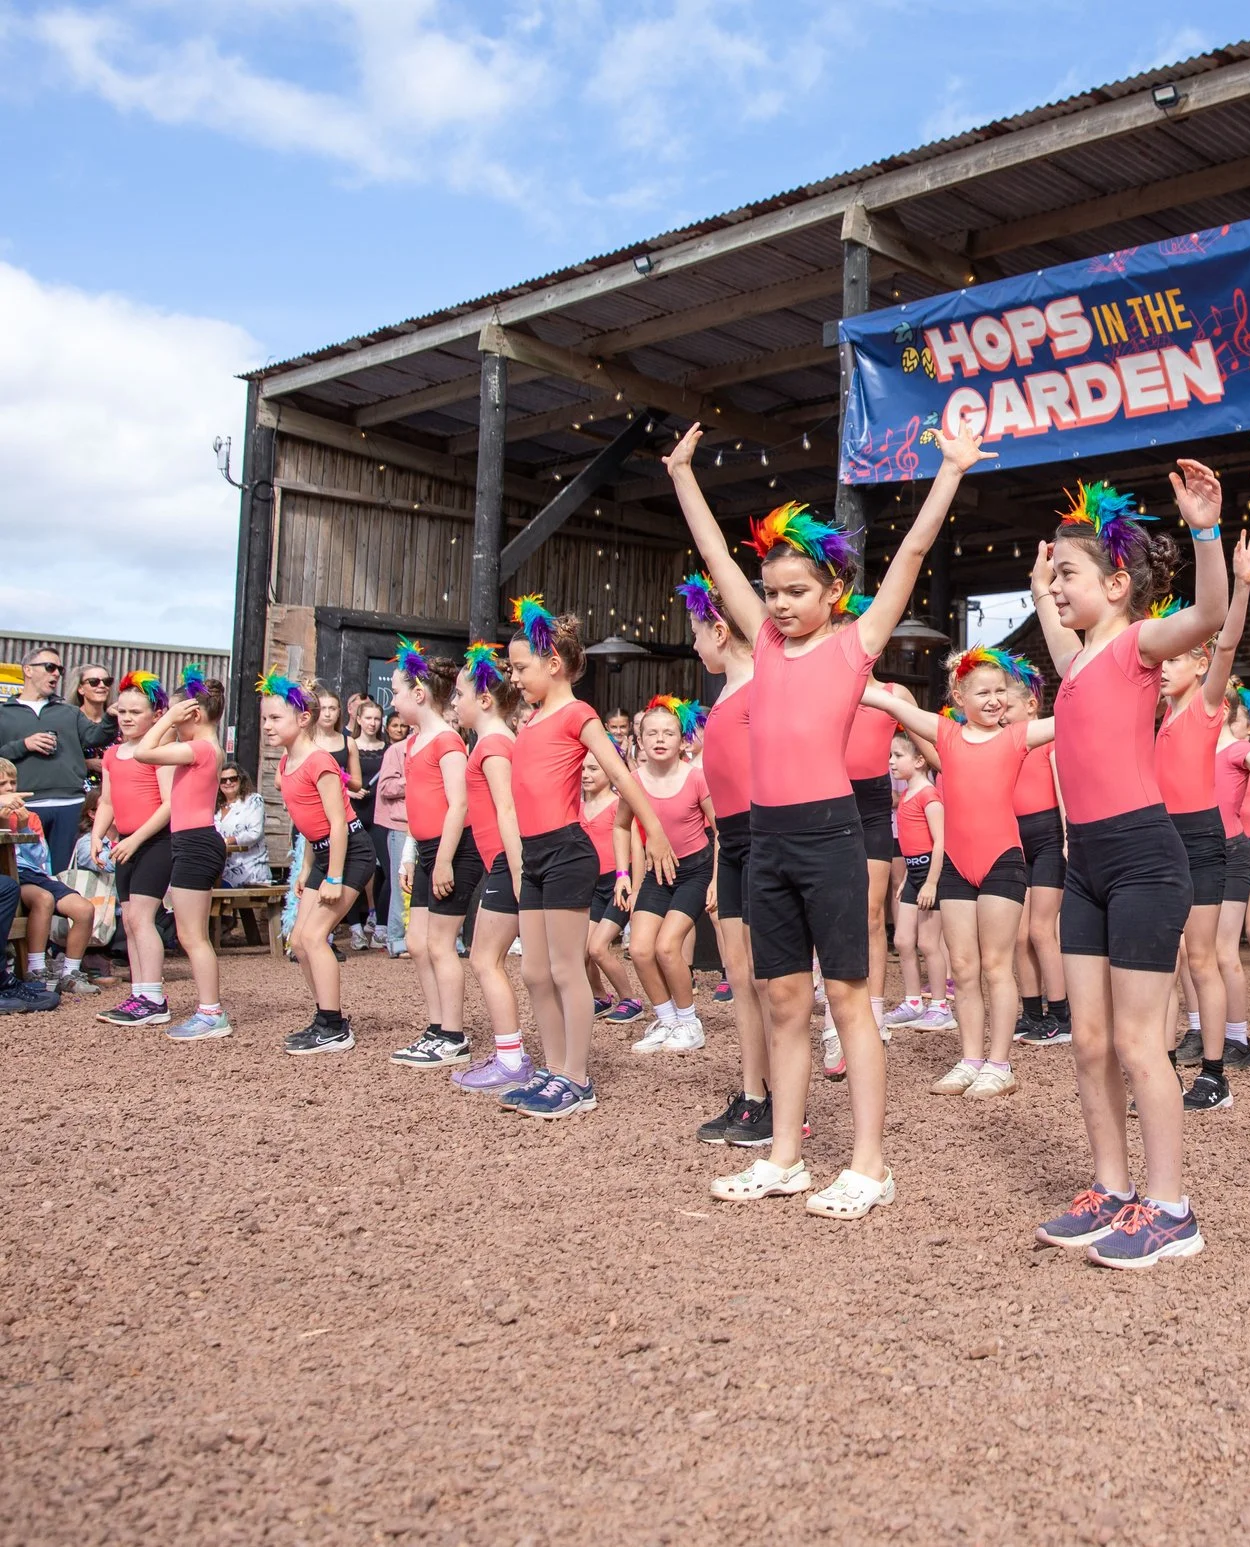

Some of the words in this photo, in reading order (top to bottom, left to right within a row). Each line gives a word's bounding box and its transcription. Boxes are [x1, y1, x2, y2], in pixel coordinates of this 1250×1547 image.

[924, 296, 1093, 383] HOPS
[1091, 301, 1129, 346] IN
[1127, 288, 1193, 338] THE
[942, 338, 1225, 443] GARDEN
[906, 855, 930, 866] PRO
